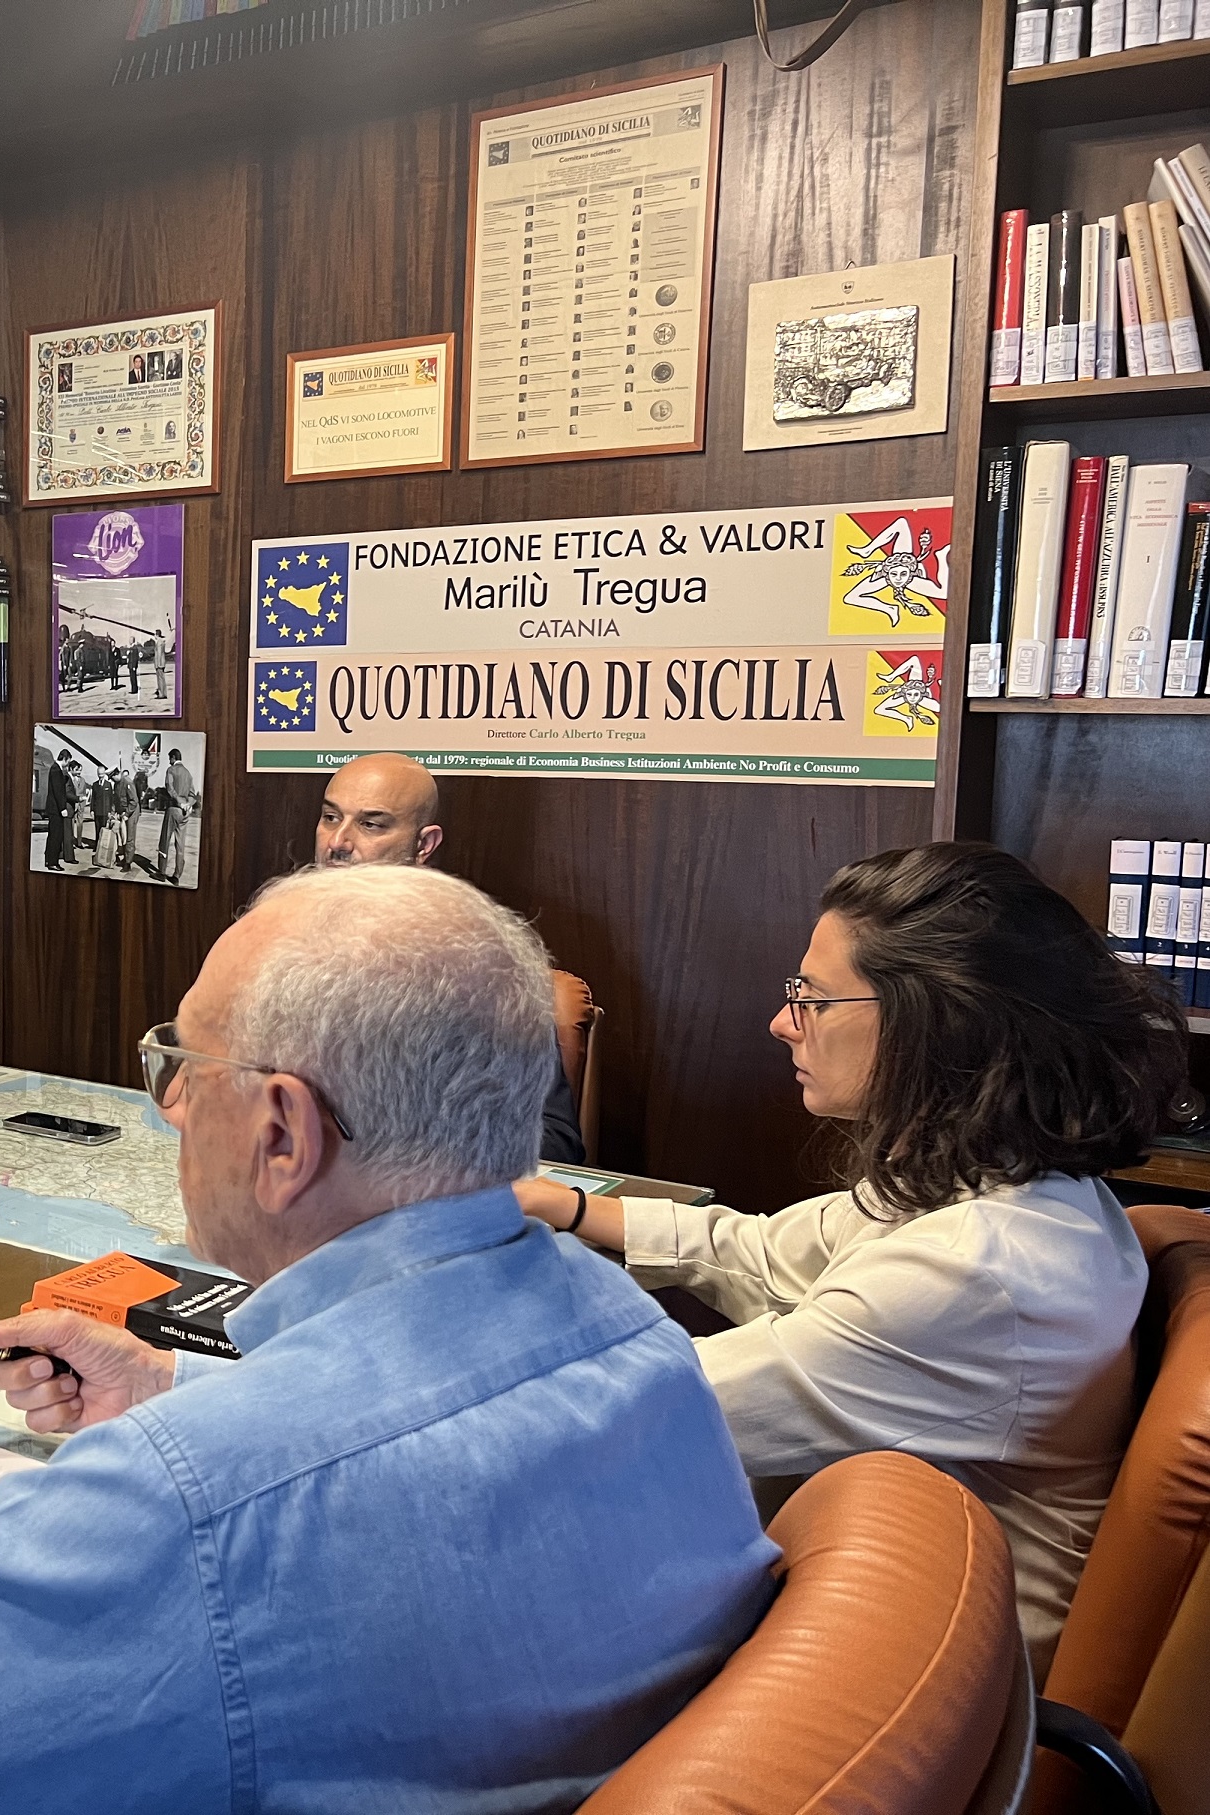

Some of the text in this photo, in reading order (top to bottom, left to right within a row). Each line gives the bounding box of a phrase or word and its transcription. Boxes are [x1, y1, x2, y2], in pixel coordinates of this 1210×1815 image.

[531, 115, 651, 150] QUOTIDIANO DI SICILIA
[559, 147, 622, 164] Comitato scientifico
[328, 367, 372, 386] QUOTIDIANO
[374, 366, 383, 378] DI
[383, 363, 409, 377] SICILIA
[301, 406, 437, 428] NEL QdS VI SONO LOCOMOTIVE
[321, 434, 353, 444] VAGONI
[355, 430, 390, 442] ESCONO
[392, 427, 419, 438] FUORI
[994, 471, 1003, 493] SIENA
[354, 518, 826, 571] FONDAZIONE ETICA & VALORI
[444, 567, 708, 614] Marilù Tregua
[518, 617, 621, 640] CATANIA
[328, 657, 846, 733] QUOTIDIANO DI SICILIA
[486, 729, 646, 741] Direttore Carlo Alberto Tregua
[316, 754, 324, 764] Il
[426, 754, 441, 765] dal
[443, 755, 469, 765] 1979:
[471, 756, 515, 767] regionale
[517, 755, 527, 766] di
[529, 756, 579, 767] Economia
[581, 757, 625, 768] Business
[627, 757, 681, 769] Istituzioni
[683, 759, 737, 770] Ambiente
[739, 760, 756, 771] No
[758, 760, 791, 772] Profit
[794, 764, 801, 772] e
[803, 761, 860, 774] Consumo
[160, 1325, 186, 1340] Tregua
[187, 1332, 217, 1347] Alberto
